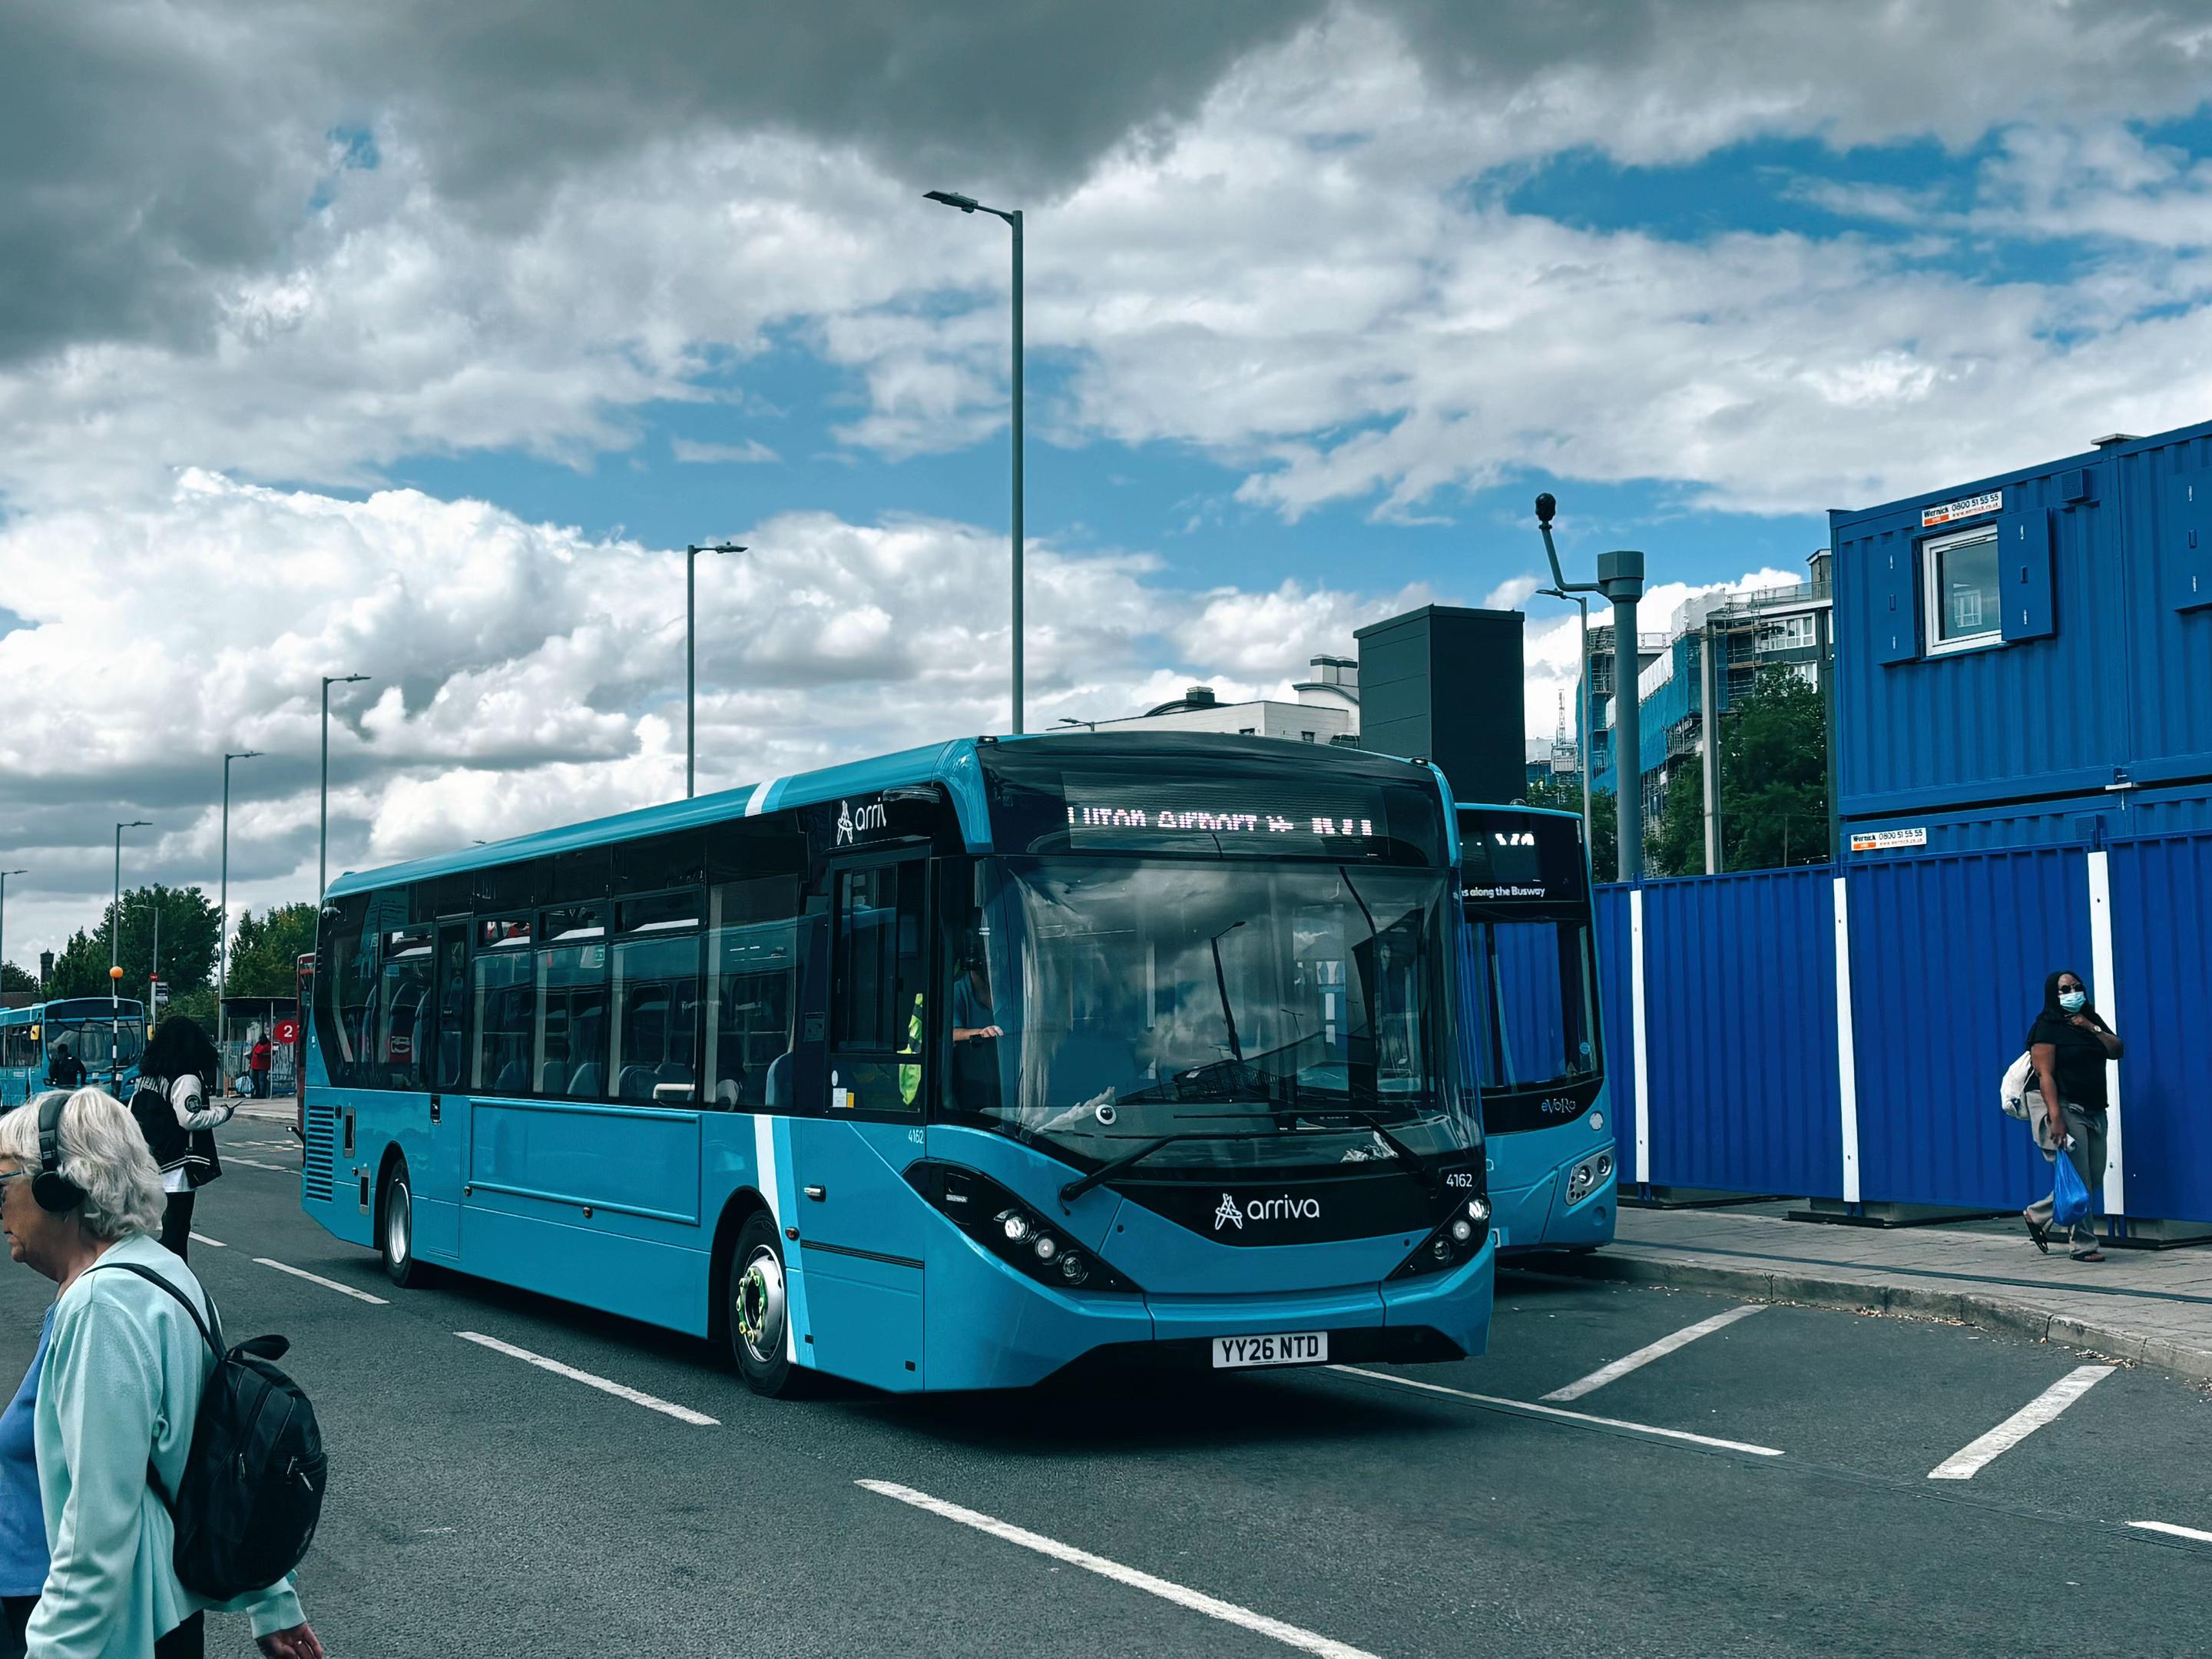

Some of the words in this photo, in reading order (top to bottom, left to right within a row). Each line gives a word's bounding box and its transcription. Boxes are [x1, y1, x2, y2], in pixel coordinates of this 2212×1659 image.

[1924, 507, 1949, 517] Wernick
[1952, 501, 1970, 512] 0800
[1879, 832, 1896, 840] 0800
[1470, 887, 1494, 899] along
[1495, 886, 1510, 896] the
[1511, 886, 1545, 897] Busway
[284, 1025, 293, 1038] 2
[1446, 1174, 1472, 1187] 4162
[1247, 1194, 1320, 1220] arriva
[1222, 1338, 1274, 1363] YY26
[1280, 1335, 1319, 1359] NTD
